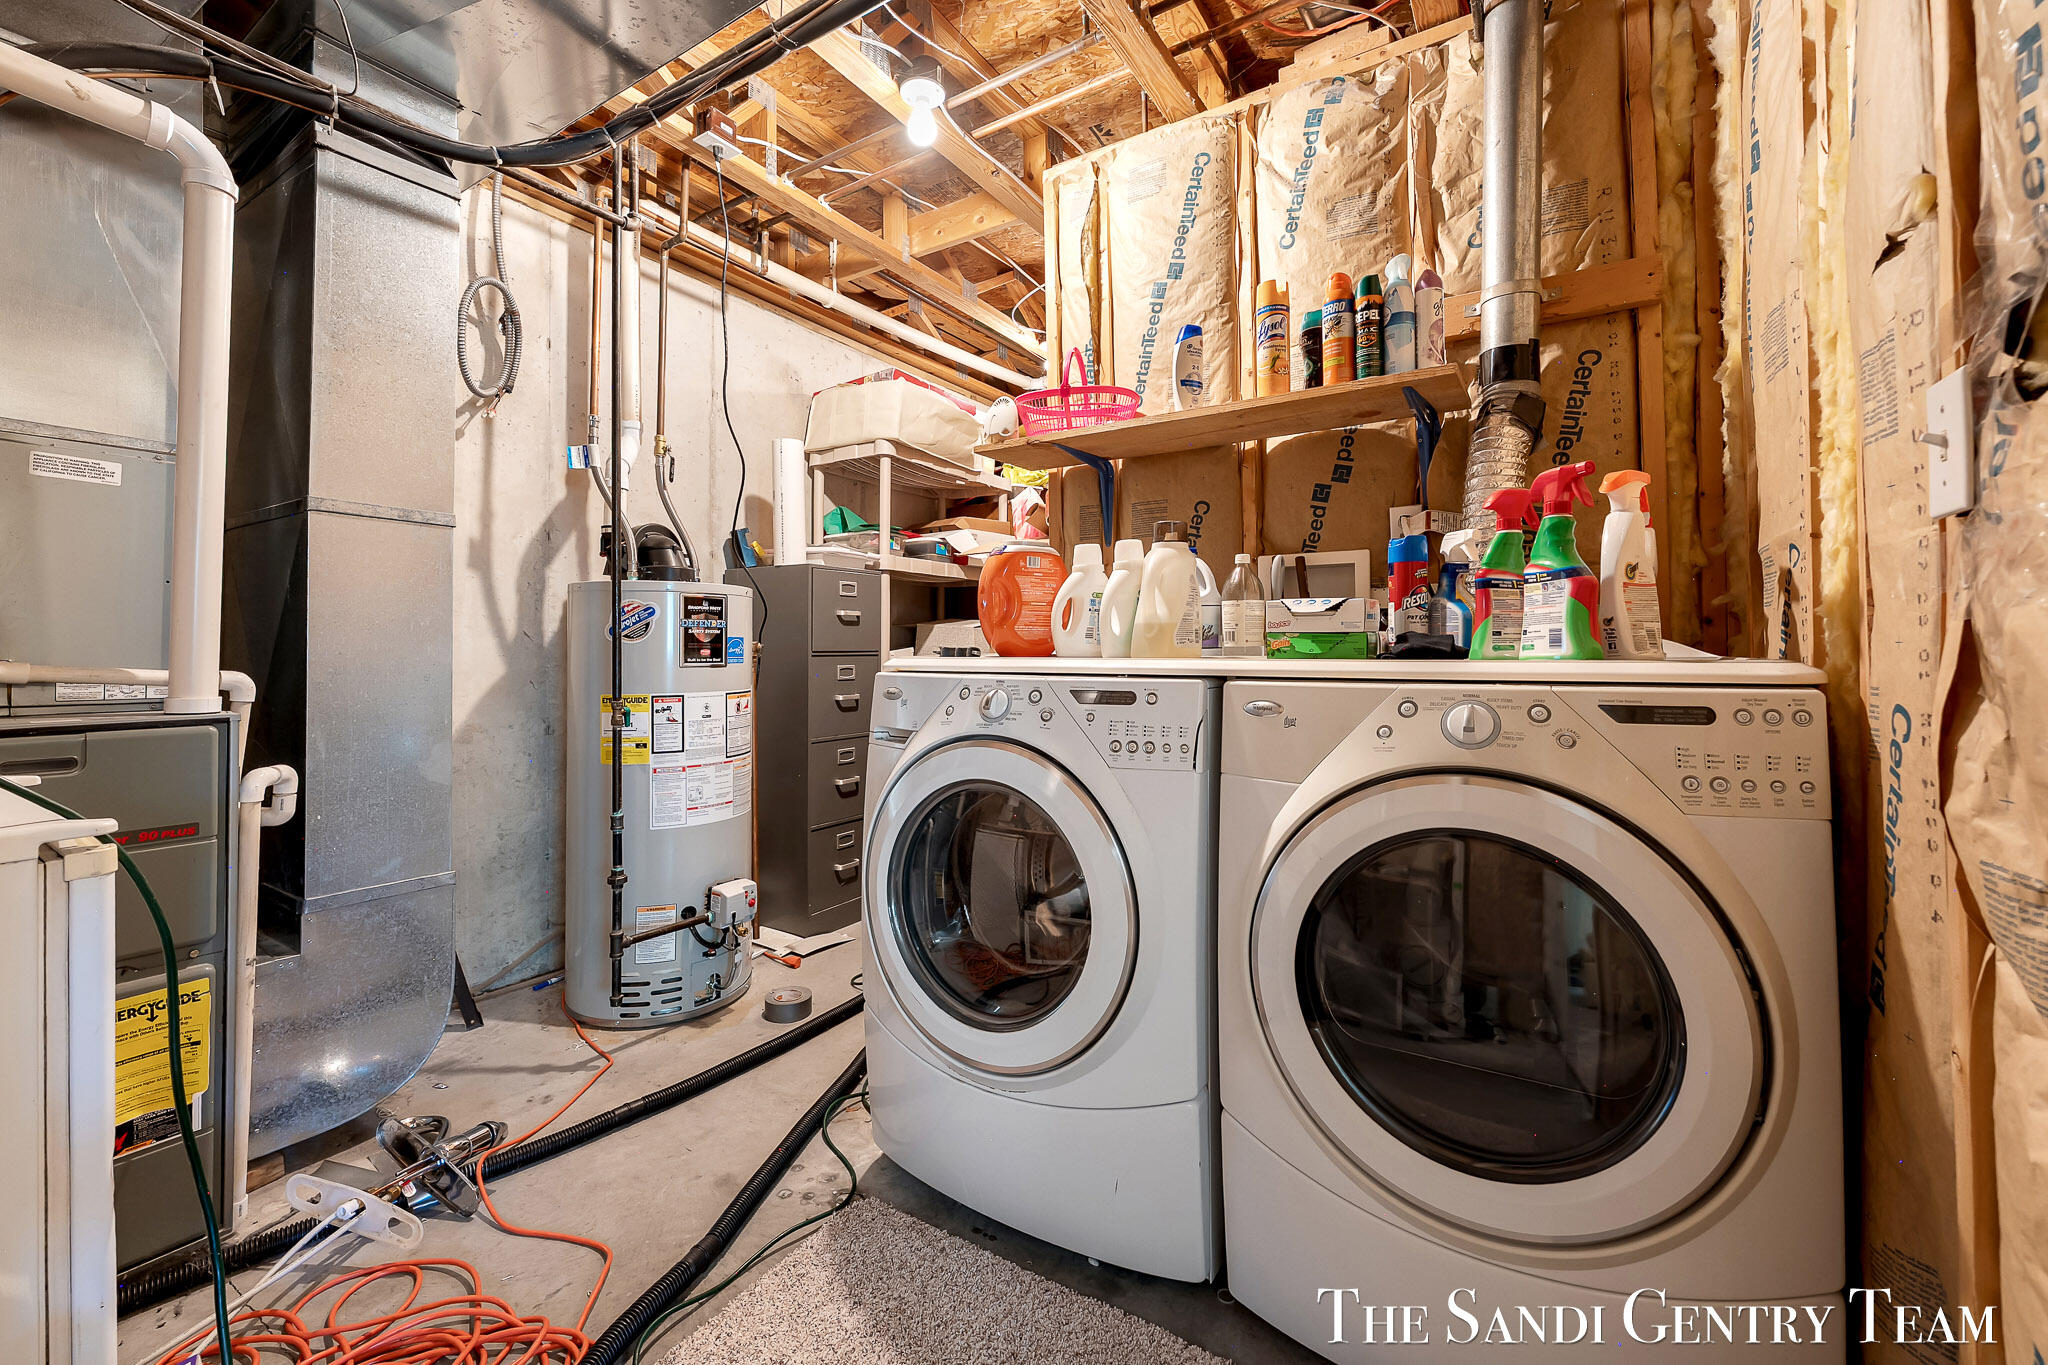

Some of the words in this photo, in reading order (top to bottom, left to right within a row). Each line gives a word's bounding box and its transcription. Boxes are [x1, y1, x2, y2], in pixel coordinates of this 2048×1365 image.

[1279, 130, 1319, 250] CertainTeed
[1171, 152, 1212, 260] CertainTeed
[1258, 316, 1287, 340] Lysol
[1552, 349, 1603, 466] CertainTee
[681, 619, 726, 627] DEFENDER
[1271, 639, 1291, 650] Gain
[138, 830, 159, 842] 90
[161, 827, 196, 840] PLUS
[116, 990, 201, 1022] ERGYGDE
